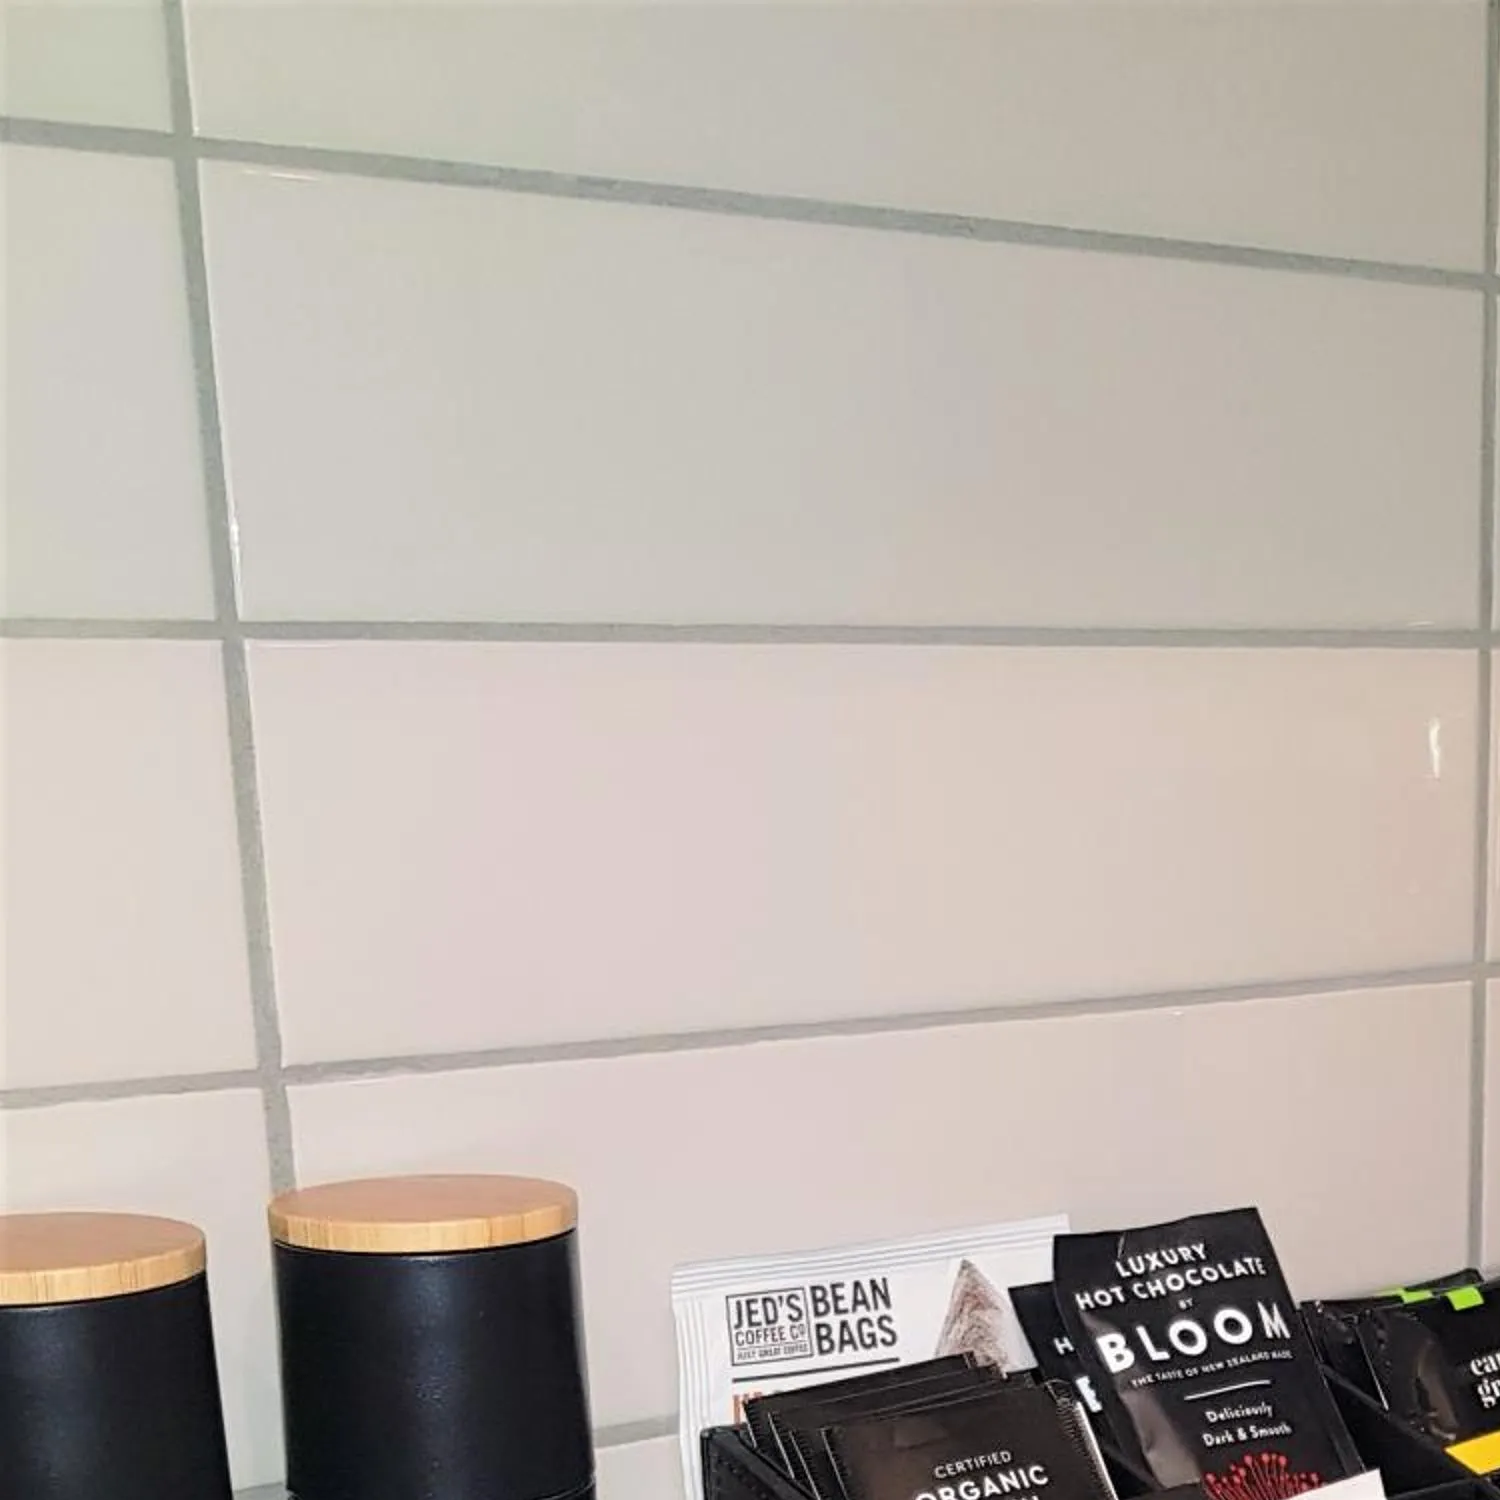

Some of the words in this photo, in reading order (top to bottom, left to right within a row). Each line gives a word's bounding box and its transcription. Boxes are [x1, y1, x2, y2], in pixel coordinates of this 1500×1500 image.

[1115, 1243, 1207, 1278] LUXURY
[809, 1277, 892, 1318] BEAN
[1075, 1286, 1126, 1312] HOT
[1132, 1256, 1268, 1299] CHOCOLATE
[734, 1293, 804, 1330] JED'S
[735, 1325, 787, 1347] COFFEE
[815, 1315, 897, 1356] BAGS
[1096, 1300, 1291, 1374] BLOOM
[1130, 1373, 1154, 1388] THE
[1155, 1368, 1184, 1382] TASTE
[1205, 1401, 1274, 1423] Deliciously
[1202, 1429, 1235, 1447] Dark
[1237, 1427, 1249, 1442] &
[1250, 1421, 1293, 1439] Smooth
[934, 1450, 1011, 1479] CERTIFIED
